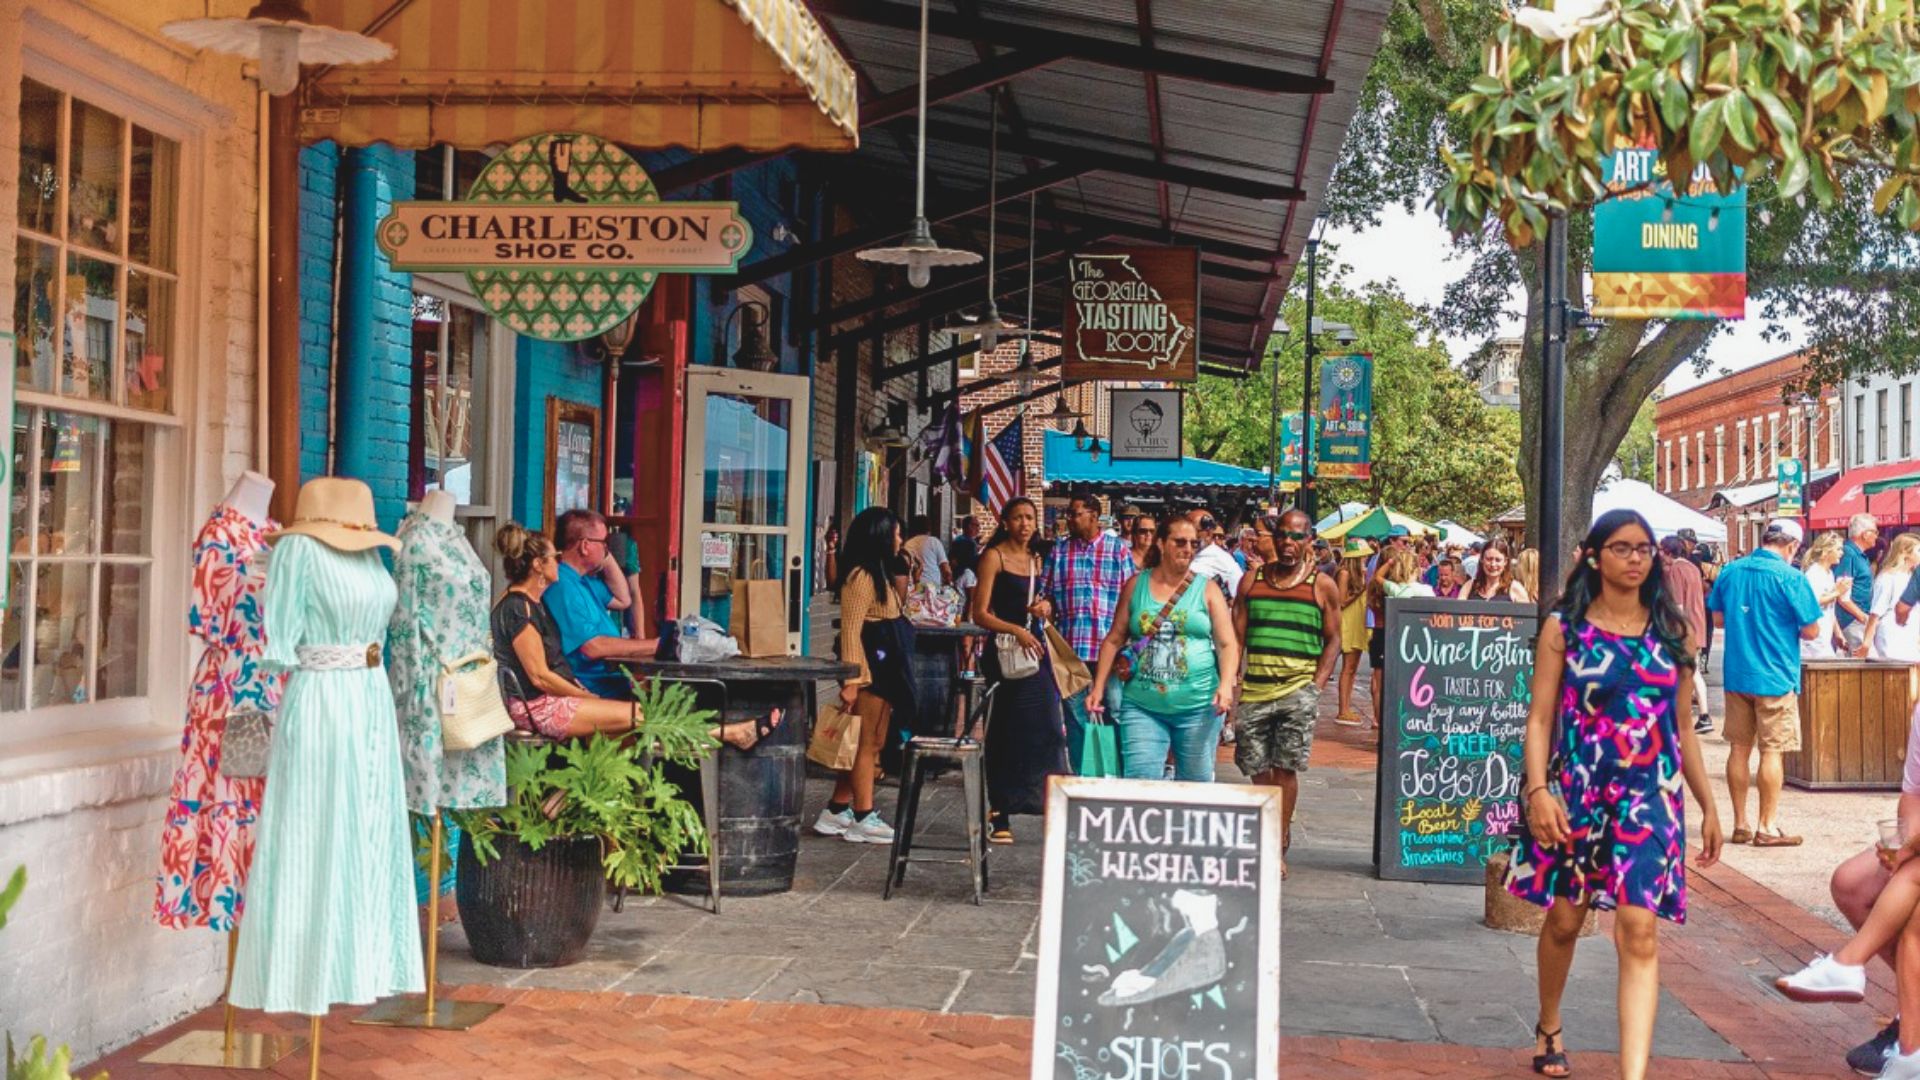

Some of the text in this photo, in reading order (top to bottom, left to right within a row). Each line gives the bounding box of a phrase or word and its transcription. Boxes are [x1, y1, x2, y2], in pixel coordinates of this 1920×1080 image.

[1613, 151, 1651, 181] ART
[421, 214, 709, 241] CHARLESTON
[1641, 223, 1698, 249] DINING
[495, 243, 634, 260] SHOE CO.
[1078, 260, 1104, 279] The
[1072, 281, 1149, 301] GEORGIA
[1083, 303, 1167, 331] TASTING
[1105, 332, 1167, 352] ROOM
[1458, 615, 1474, 627] us
[1478, 615, 1499, 628] for
[1401, 625, 1533, 674] Wine Tastin
[1410, 665, 1434, 707] 6
[1444, 677, 1480, 696] TASTES
[1484, 679, 1506, 699] FOR
[1428, 701, 1528, 724] Buy any bottle
[1406, 714, 1438, 733] and
[1441, 723, 1484, 744] your
[1476, 751, 1521, 799] Dri
[1400, 801, 1457, 826] Local
[1417, 817, 1461, 834] Beer
[1078, 806, 1258, 850] MACHINE
[1401, 846, 1465, 867] Smoothies
[1101, 851, 1257, 890] WASHABLE
[1105, 1036, 1233, 1080] SHOES
